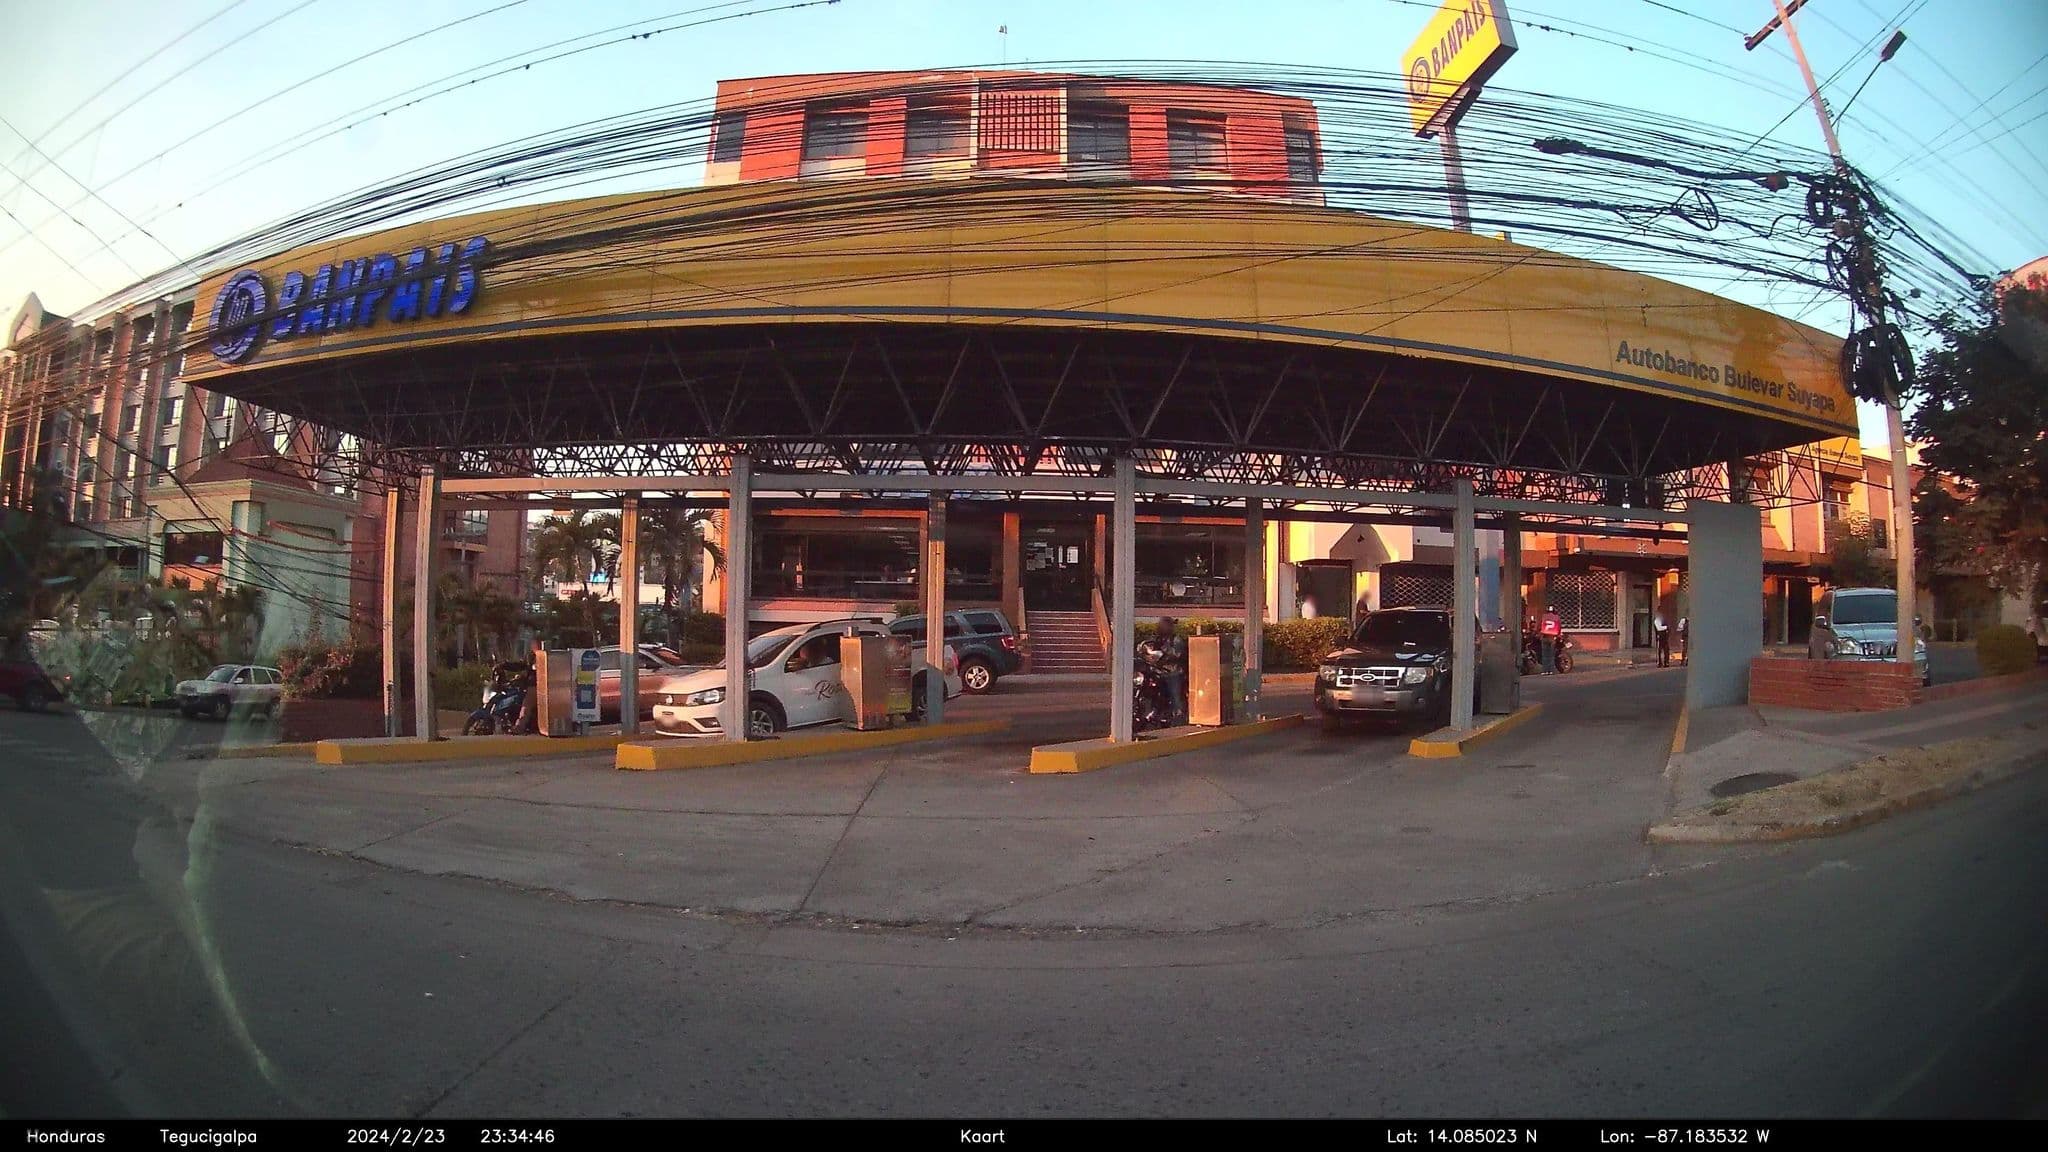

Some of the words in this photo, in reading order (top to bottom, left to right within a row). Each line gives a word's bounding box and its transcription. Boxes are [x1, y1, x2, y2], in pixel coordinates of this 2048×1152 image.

[1615, 340, 1720, 384] Autobanco
[1723, 364, 1784, 399] Bulevar
[1788, 381, 1836, 414] Suyapa
